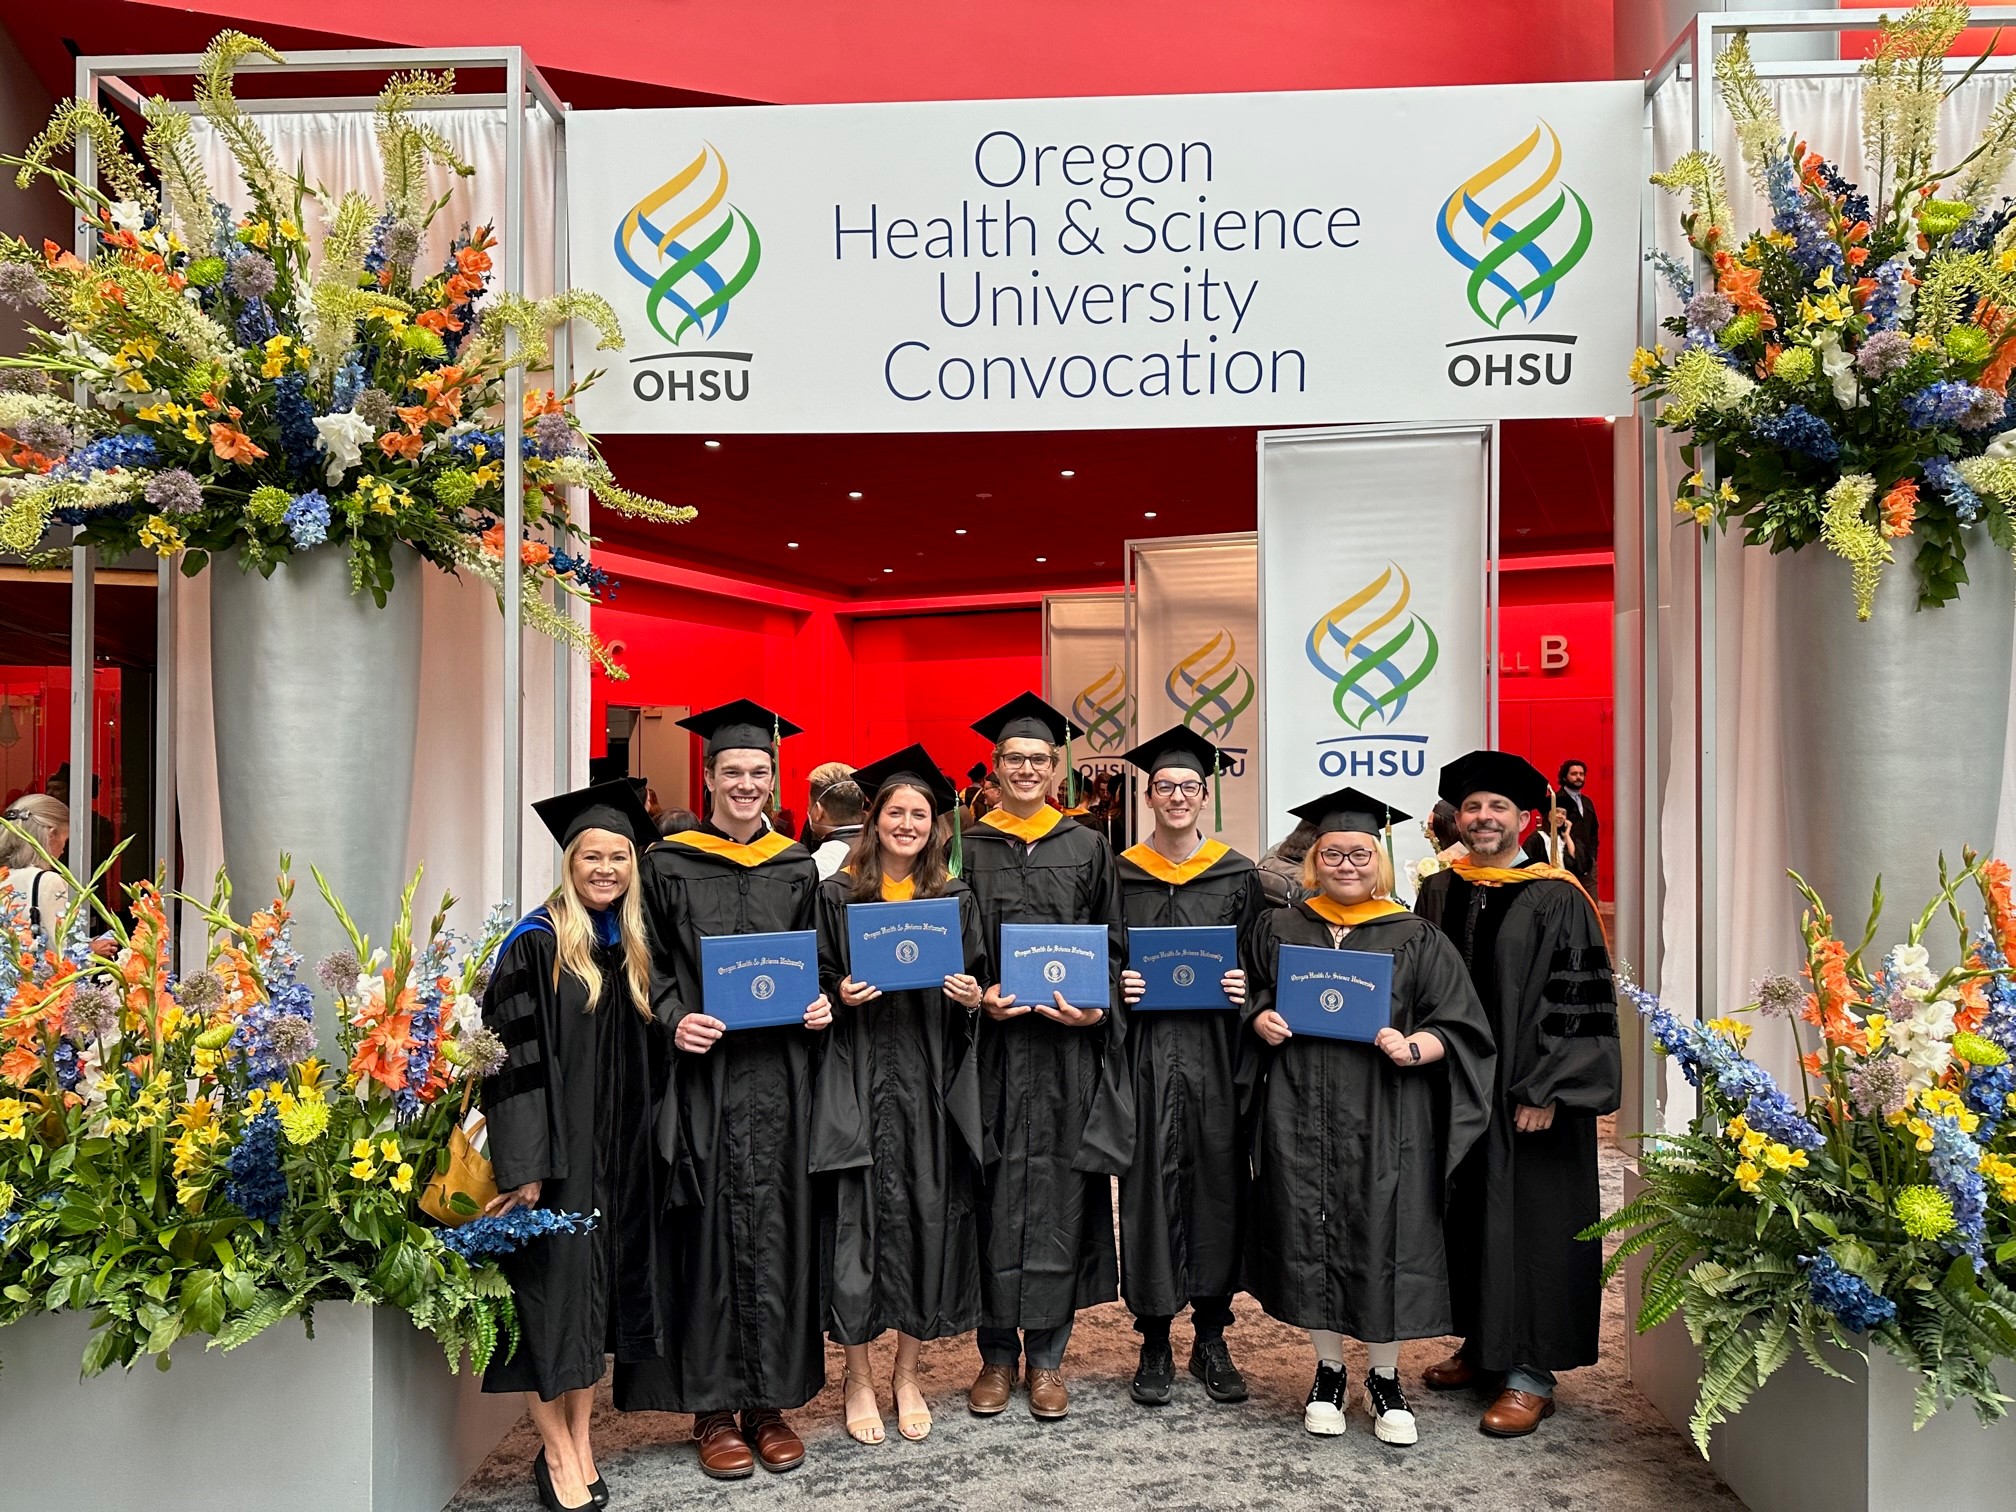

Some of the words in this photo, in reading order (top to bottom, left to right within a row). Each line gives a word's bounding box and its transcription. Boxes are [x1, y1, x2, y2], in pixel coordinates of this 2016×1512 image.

[974, 130, 1213, 199] Oregon
[835, 198, 1036, 260] Health
[1057, 198, 1105, 256] &
[1122, 195, 1361, 254] Science
[939, 265, 1259, 334] University
[884, 335, 1305, 402] Convocation
[1447, 352, 1572, 387] OHSU
[633, 369, 749, 402] OHSU
[1540, 634, 1570, 669] B
[1318, 749, 1425, 777] OHSU
[864, 930, 881, 940] Oregon
[718, 965, 736, 975] Oregon
[1014, 949, 1031, 958] Oregon
[1143, 955, 1159, 963] Oregon
[1291, 974, 1308, 983] Oregon
